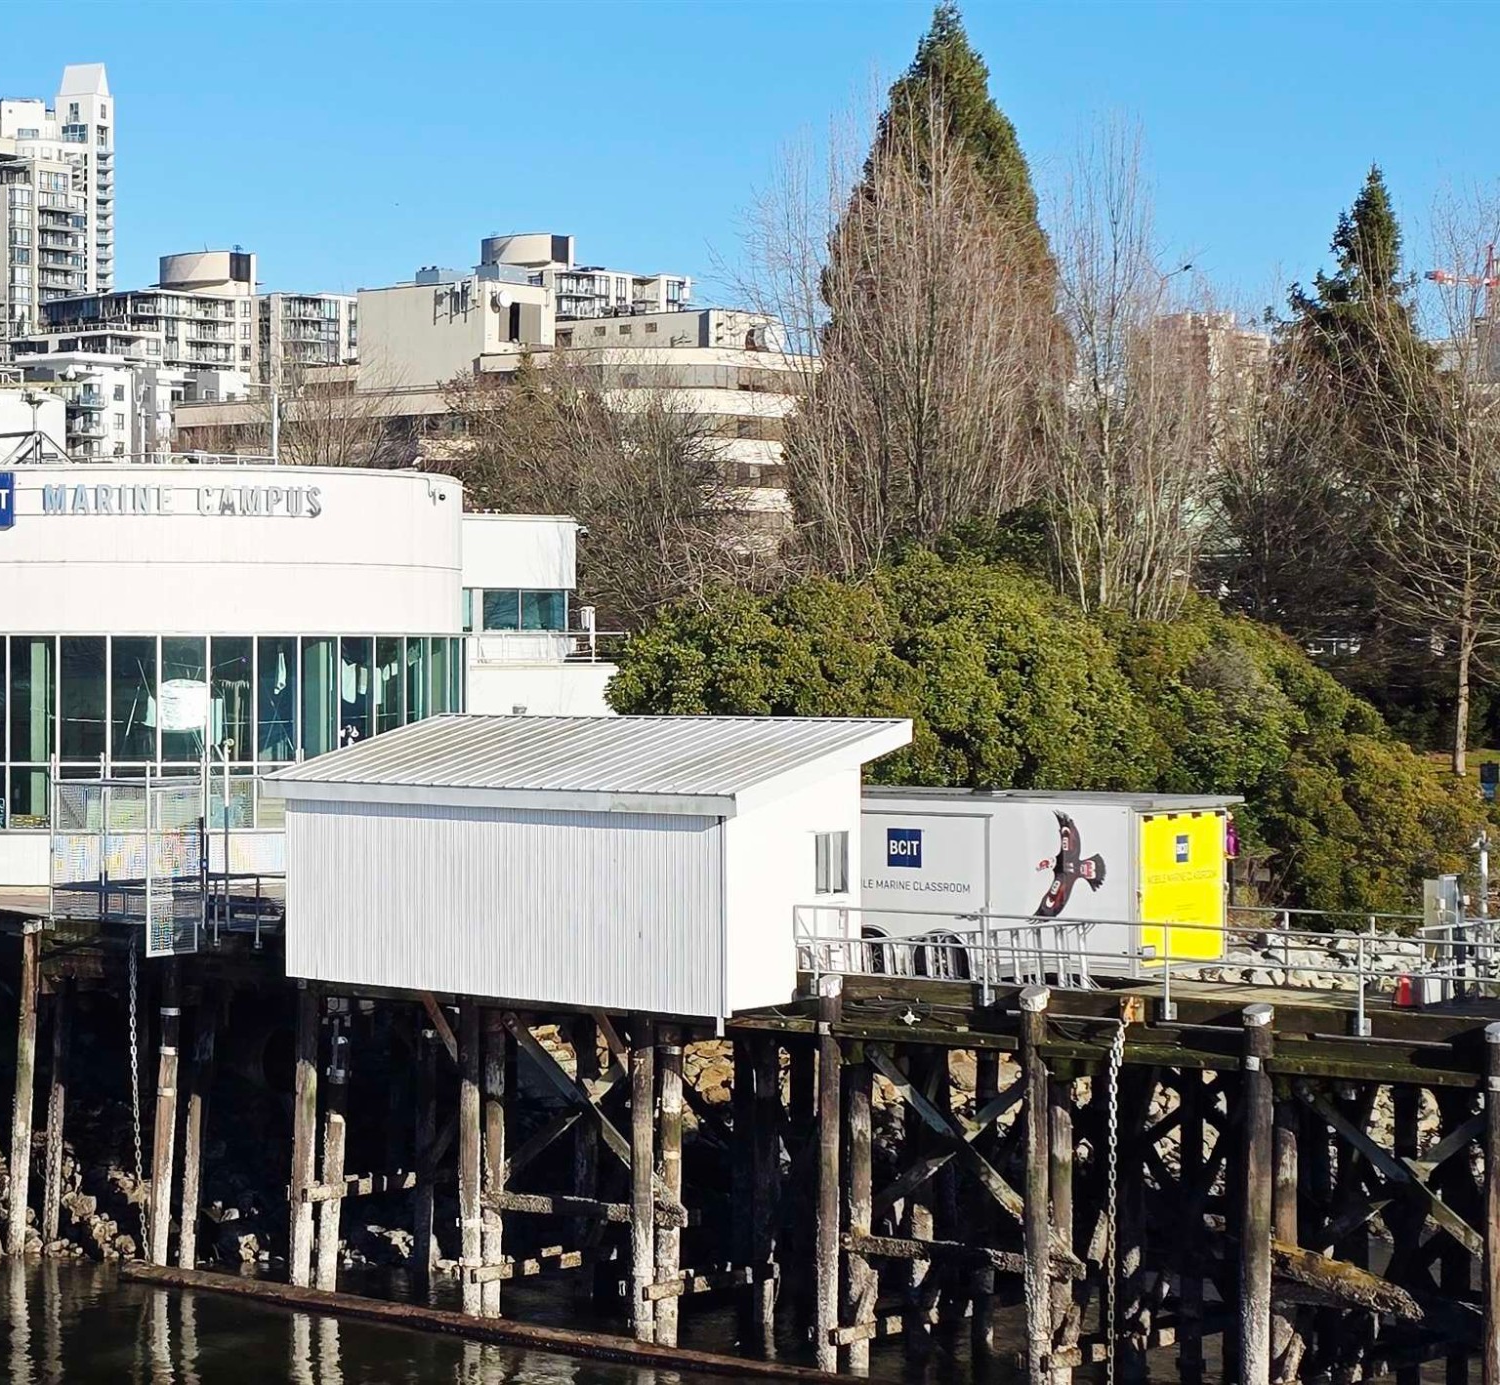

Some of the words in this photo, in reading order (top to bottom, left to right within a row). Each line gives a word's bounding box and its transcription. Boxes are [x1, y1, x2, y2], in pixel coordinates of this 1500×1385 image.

[42, 483, 174, 517] MARINE
[196, 484, 322, 519] CAMPUS
[889, 839, 920, 856] BCIT
[876, 879, 911, 891] MARINE
[912, 880, 971, 893] CLASSROOM
